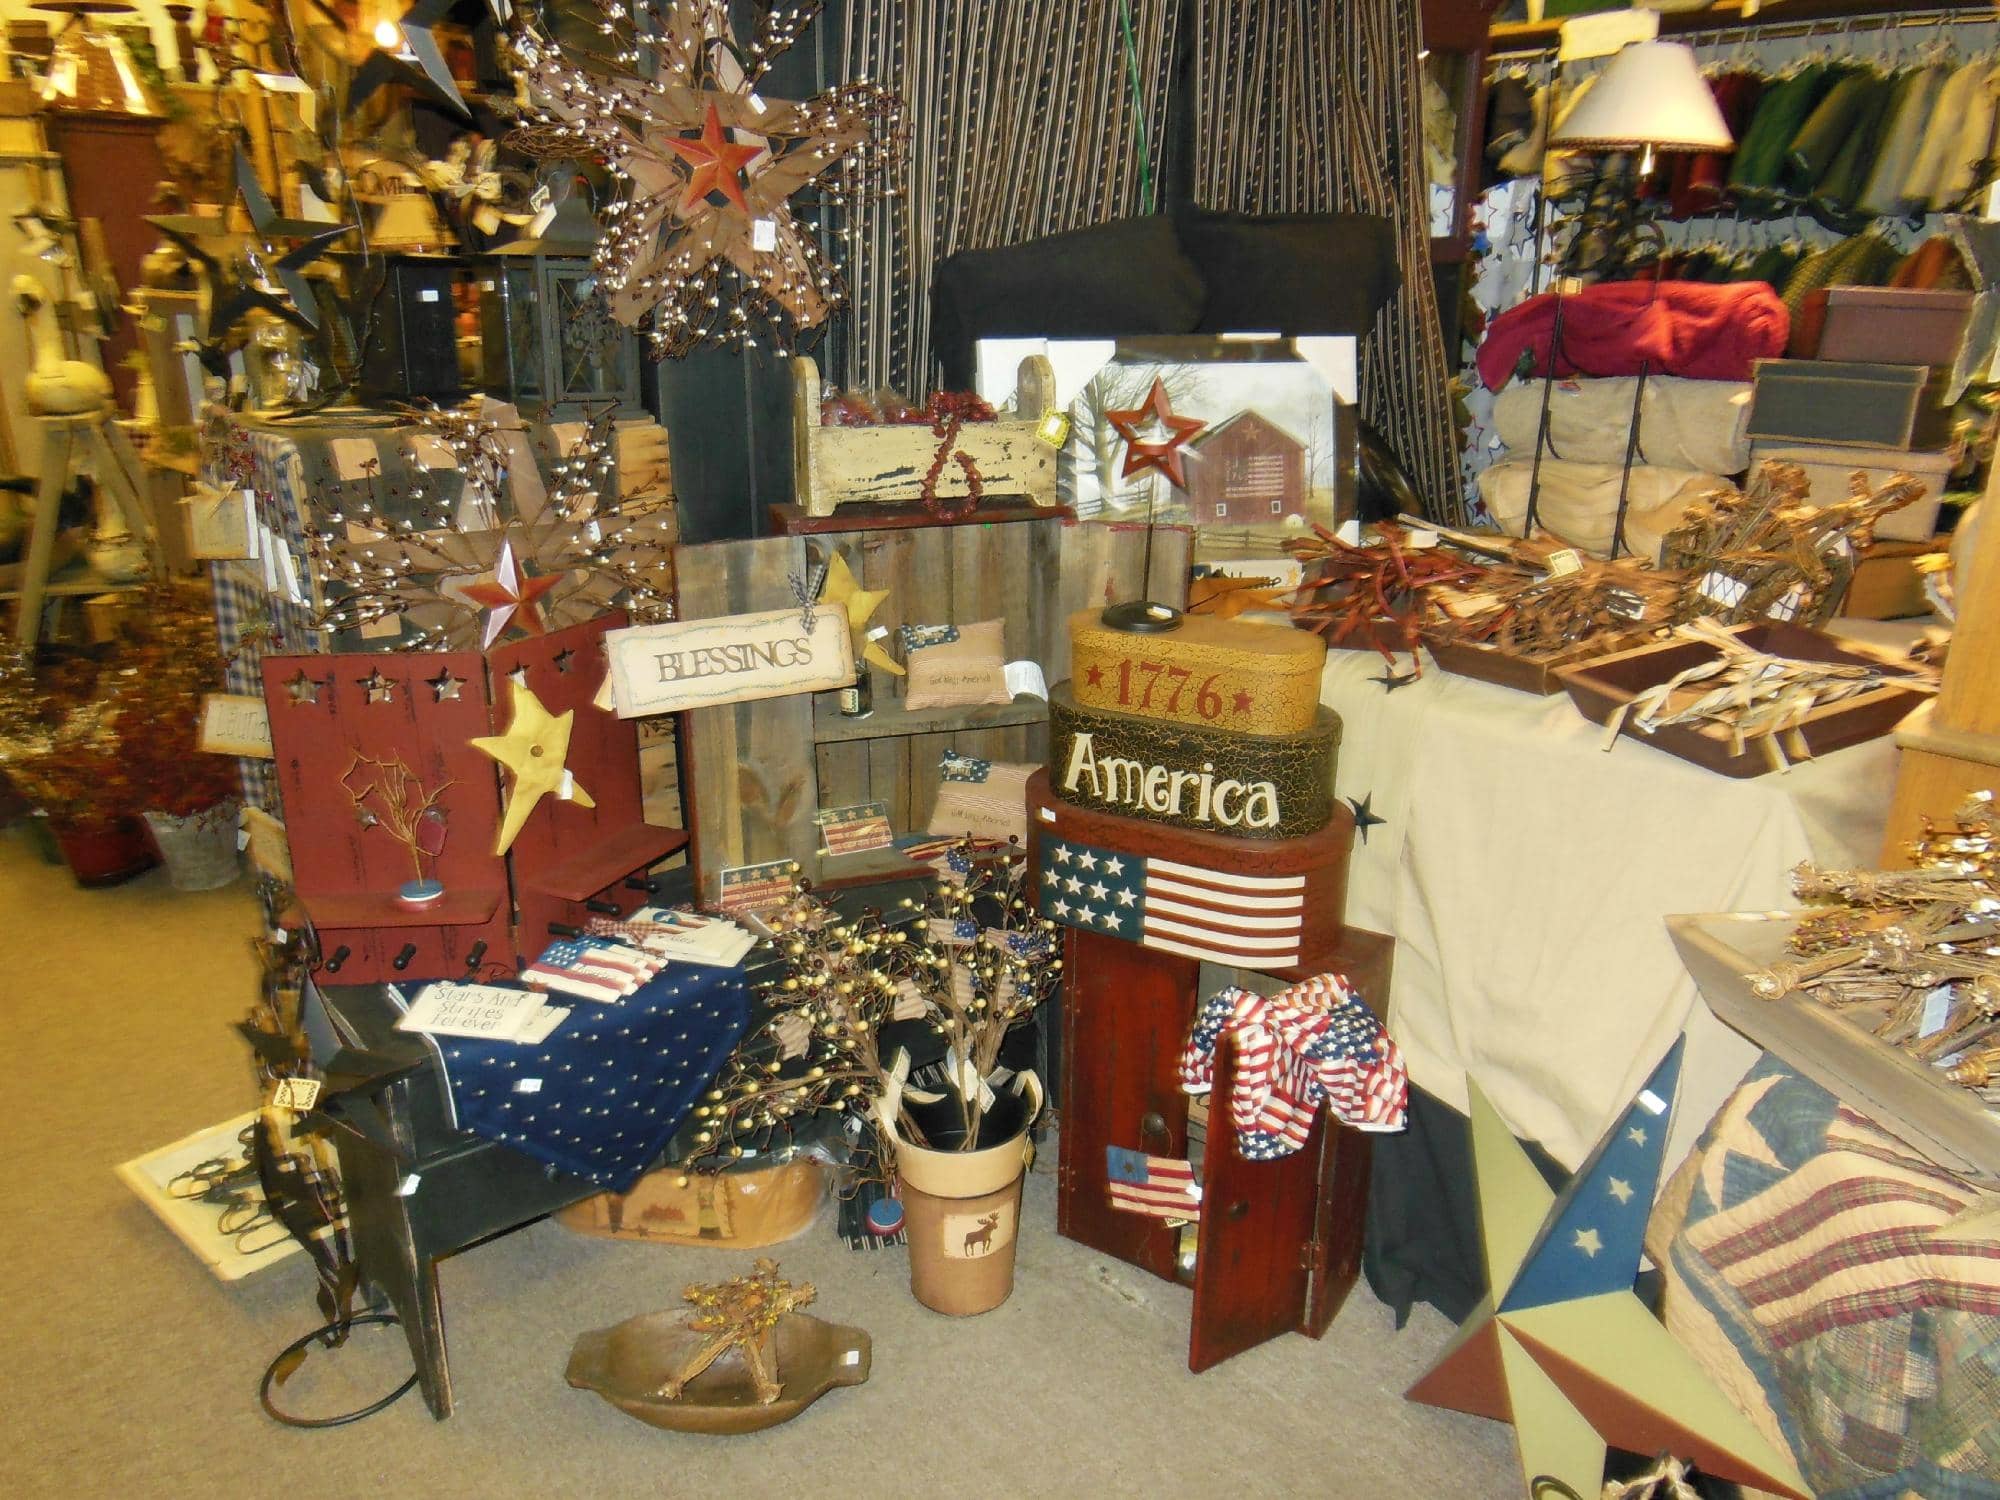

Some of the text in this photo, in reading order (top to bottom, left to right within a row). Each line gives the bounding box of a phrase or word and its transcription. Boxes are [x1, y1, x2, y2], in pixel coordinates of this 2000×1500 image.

[654, 637, 813, 683] BLESSINGS
[1117, 659, 1223, 720] 1776
[1064, 732, 1280, 829] America
[435, 988, 483, 1003] Stars
[439, 1001, 504, 1019] Stripes
